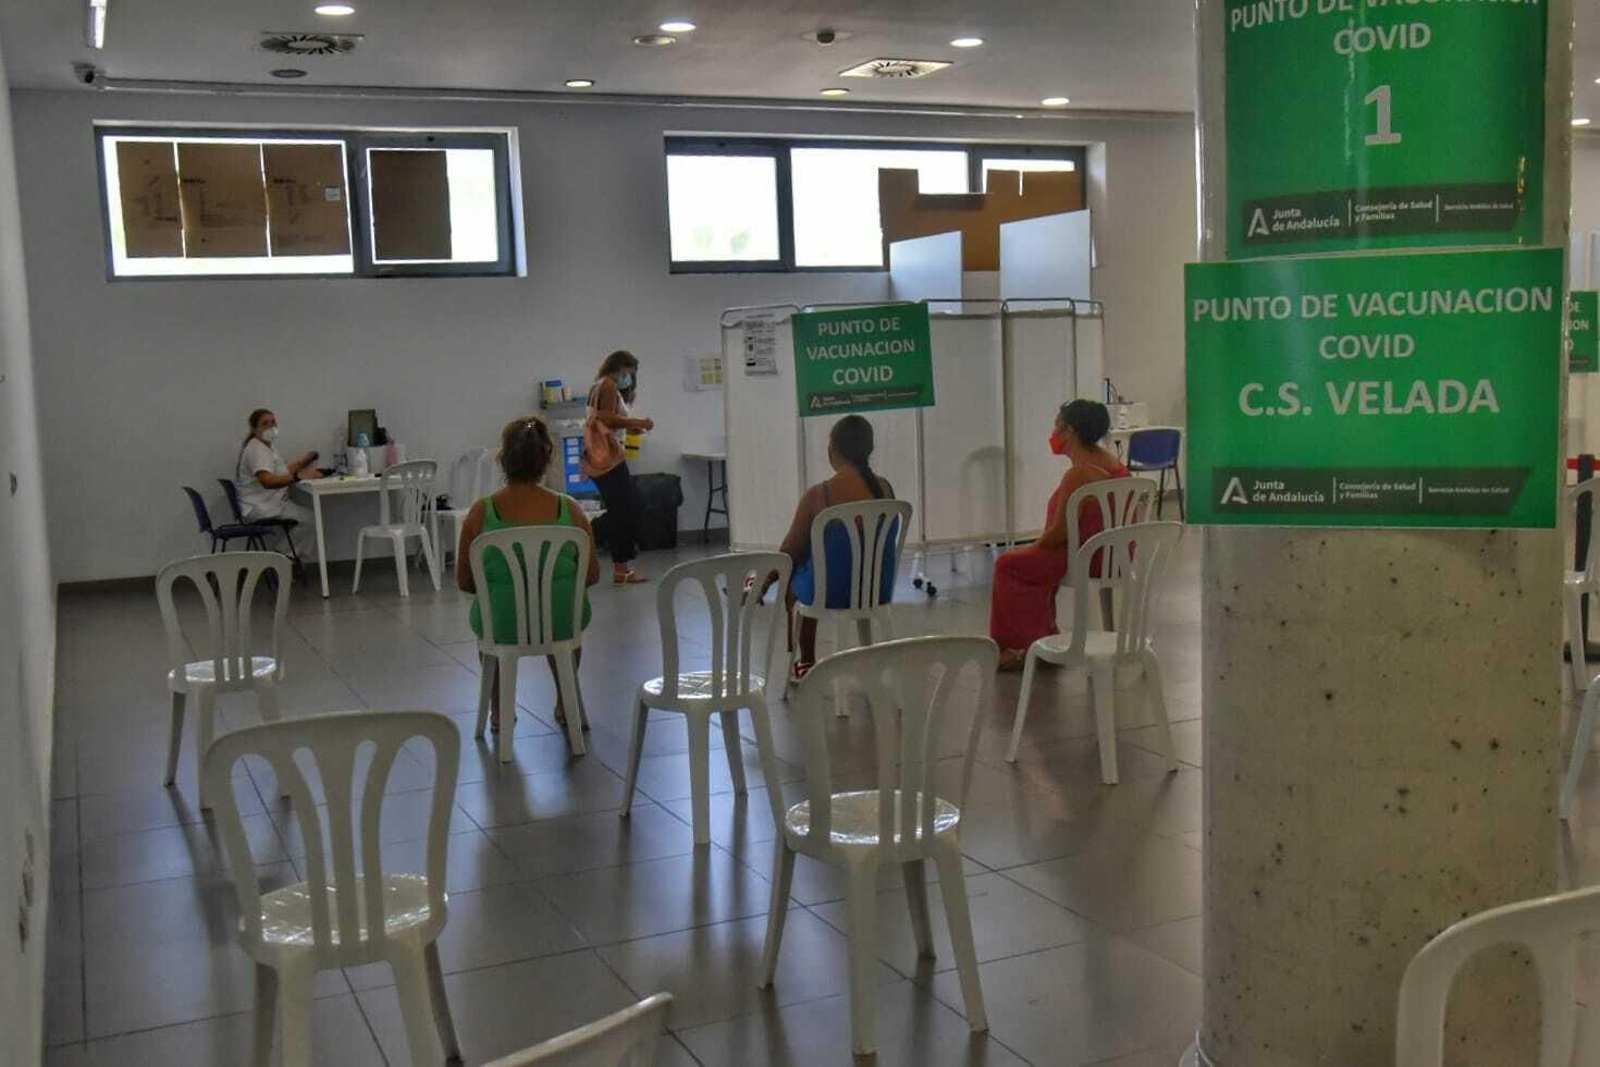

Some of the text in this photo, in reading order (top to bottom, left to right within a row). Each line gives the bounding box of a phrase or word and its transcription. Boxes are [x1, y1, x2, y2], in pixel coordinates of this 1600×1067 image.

[1231, 0, 1308, 32] PUNTO
[1333, 22, 1432, 55] COVID
[1364, 84, 1402, 146] 1
[1272, 215, 1341, 232] de Andalucía
[1273, 208, 1302, 220] Junta
[1193, 286, 1553, 322] PUNTO DE VACUNACION
[818, 317, 900, 336] PUNTO DE
[806, 339, 915, 361] VACUNACION
[1318, 333, 1415, 360] COVID
[832, 365, 893, 386] COVID
[1238, 379, 1501, 417] C.S. VELADA
[1253, 480, 1285, 490] Junta
[1252, 490, 1325, 503] de Andalucía
